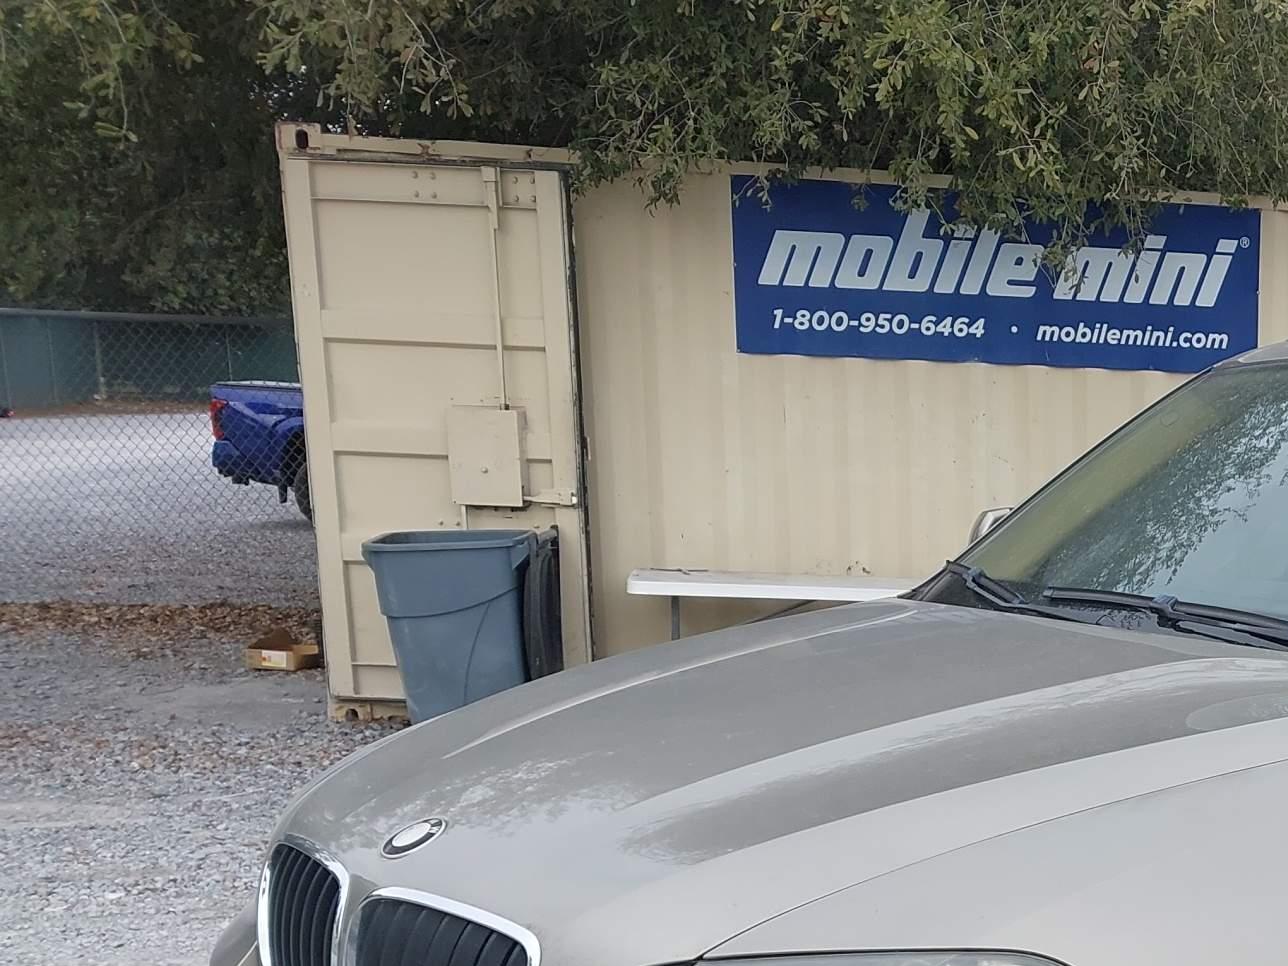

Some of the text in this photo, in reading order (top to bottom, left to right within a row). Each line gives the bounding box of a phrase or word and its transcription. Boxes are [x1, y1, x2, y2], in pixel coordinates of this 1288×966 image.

[757, 207, 1045, 298] mobile
[772, 308, 1229, 350] 1-800-950-6464 mobilemini.com
